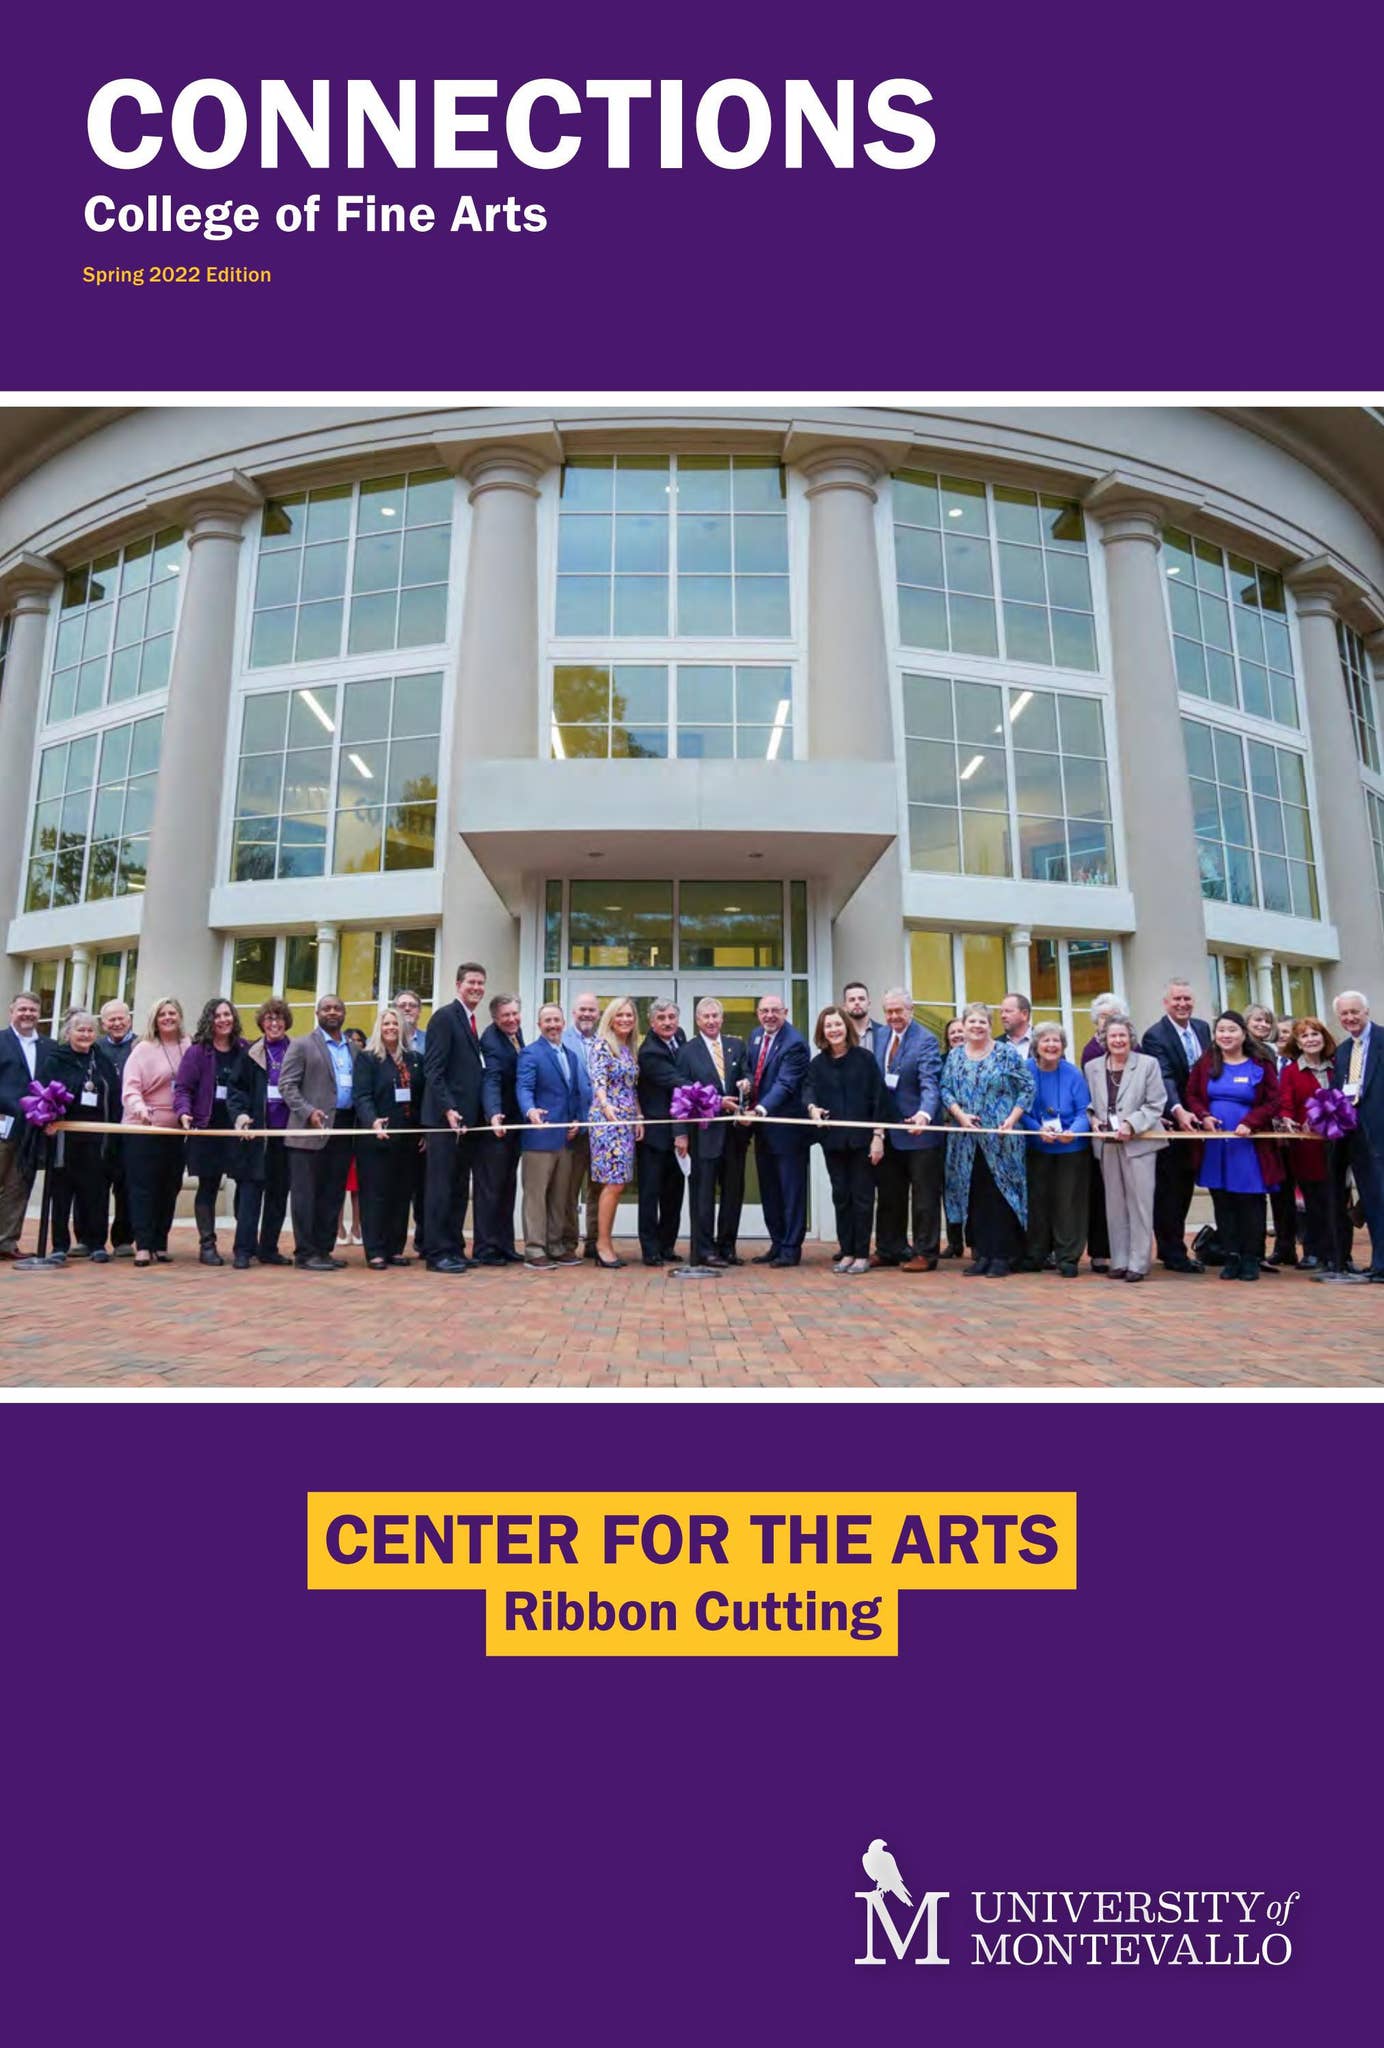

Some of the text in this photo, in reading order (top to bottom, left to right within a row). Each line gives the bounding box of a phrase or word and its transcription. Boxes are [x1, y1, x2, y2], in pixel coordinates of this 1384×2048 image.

[87, 78, 936, 170] CONNECTIONS
[85, 194, 547, 241] College of Fine Arts
[83, 266, 271, 286] Spring 2022 Edition
[326, 1514, 1058, 1565] CENTER FOR THE ARTS
[506, 1590, 882, 1640] Ribbon Cutting
[971, 1891, 1300, 1926] UNIVERSITY of
[971, 1933, 1292, 1966] MONTEVALLO
